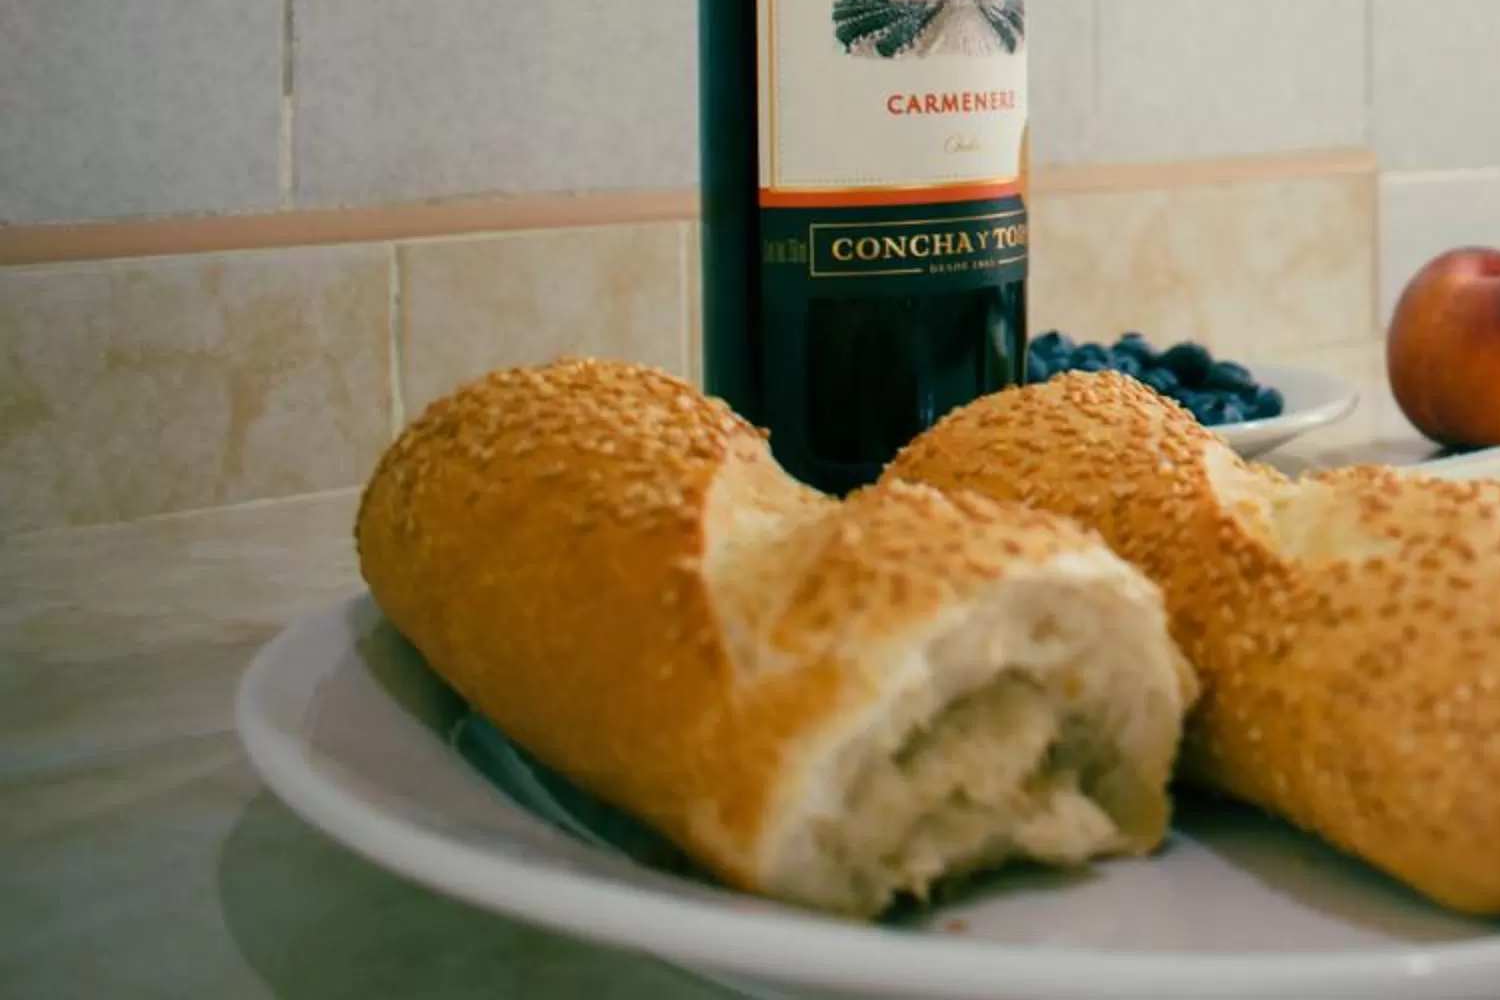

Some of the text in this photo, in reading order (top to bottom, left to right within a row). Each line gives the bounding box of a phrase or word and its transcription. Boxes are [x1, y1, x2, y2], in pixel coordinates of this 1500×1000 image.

[886, 90, 1016, 116] CARMENERE
[831, 230, 975, 262] CONCHA
[976, 230, 989, 250] Y
